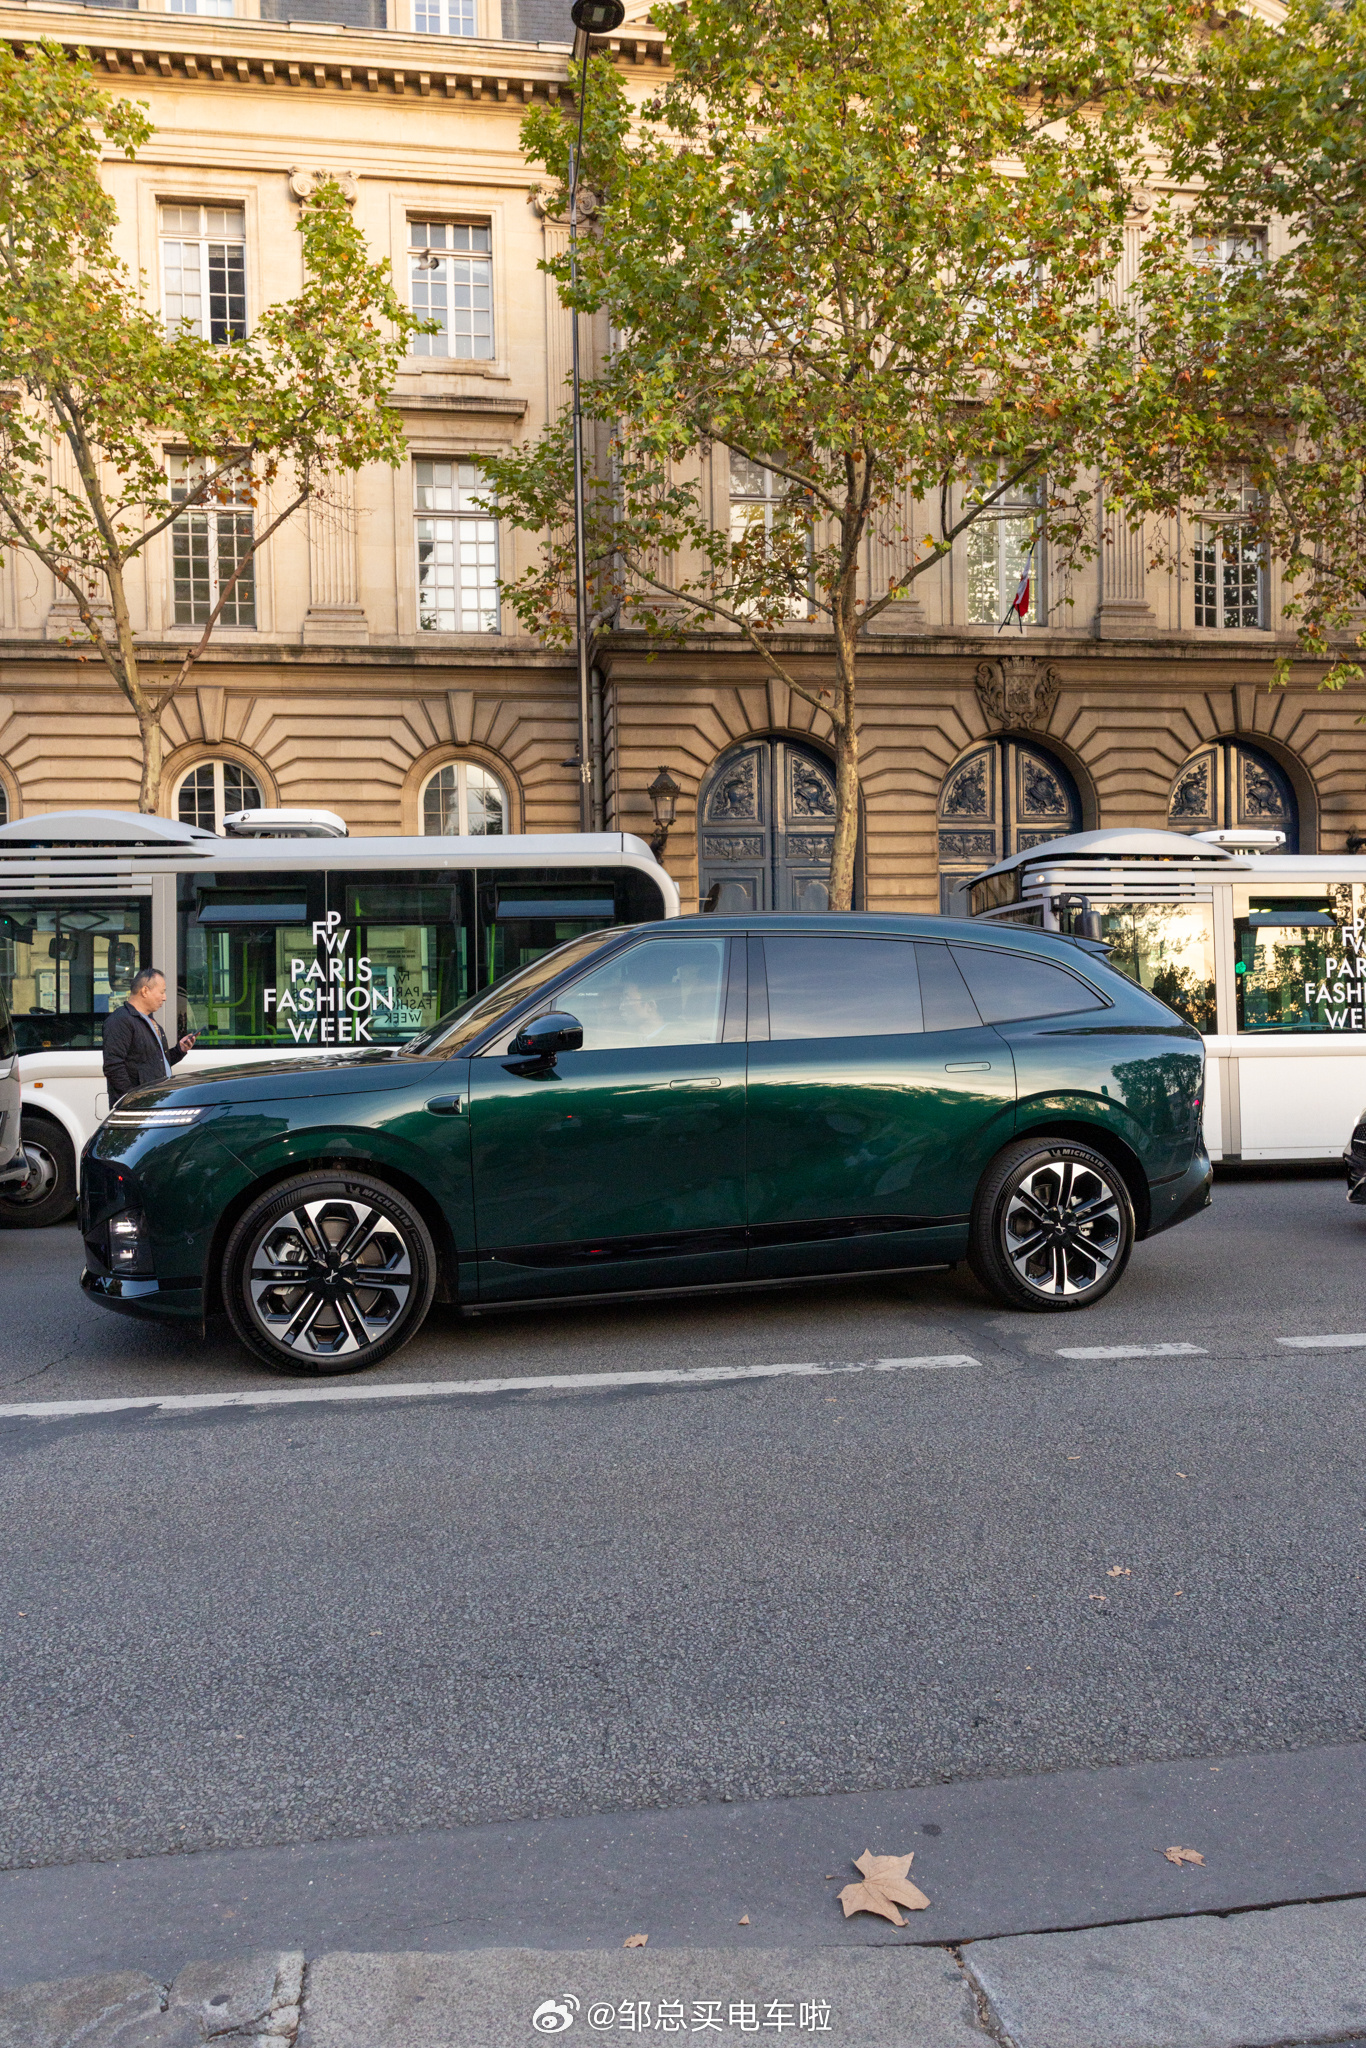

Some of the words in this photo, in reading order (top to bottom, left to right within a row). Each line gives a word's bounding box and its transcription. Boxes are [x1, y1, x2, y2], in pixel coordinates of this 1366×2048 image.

[291, 957, 372, 982] PARIS
[264, 987, 393, 1012] FASHION
[287, 1017, 373, 1042] WEEK
[1324, 1008, 1366, 1029] WE
[1062, 1148, 1105, 1168] MICHELIN
[361, 1188, 412, 1227] MICHELIN
